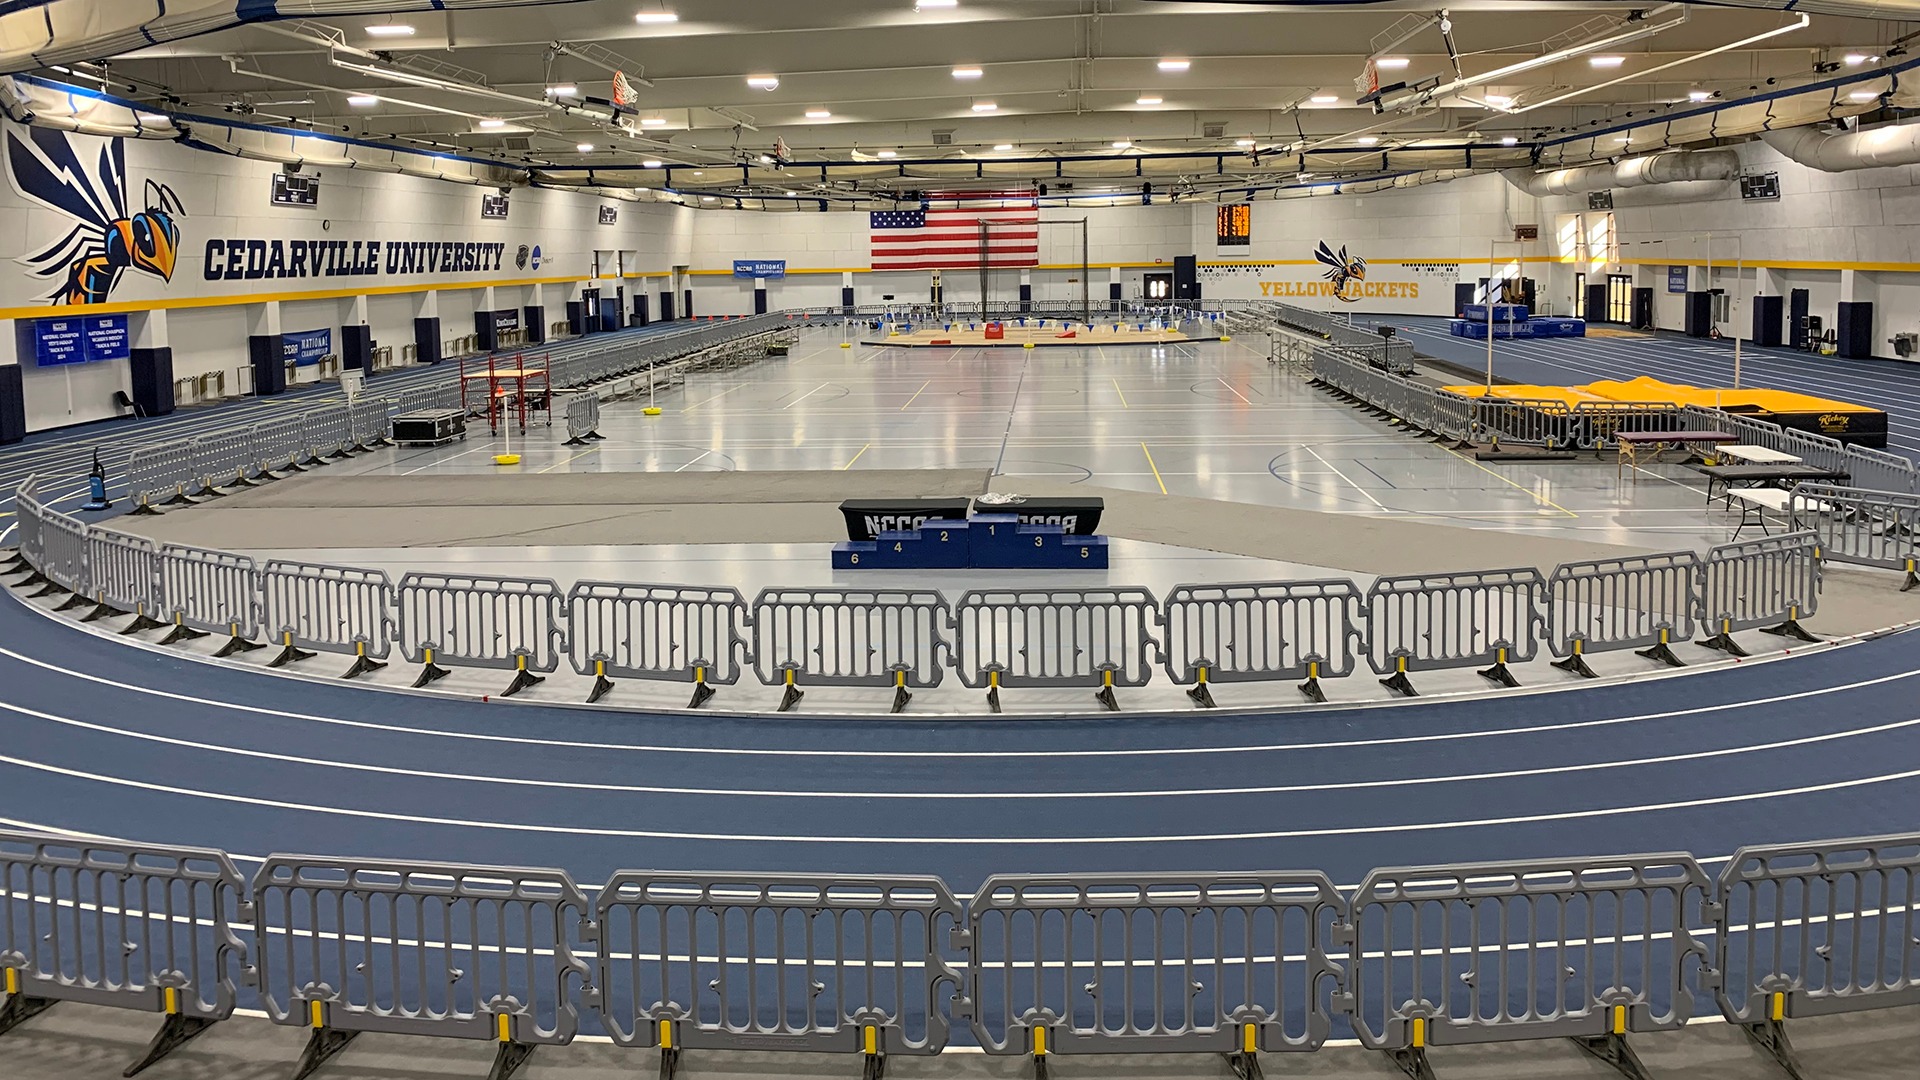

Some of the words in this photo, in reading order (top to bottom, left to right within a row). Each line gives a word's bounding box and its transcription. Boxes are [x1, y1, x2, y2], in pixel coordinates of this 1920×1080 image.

[204, 239, 380, 281] CEDARVILLE
[386, 241, 505, 274] UNIVERSITY
[1259, 281, 1337, 297] YELLOW
[1341, 282, 1419, 298] JACKETS
[301, 336, 328, 349] NATIONAL
[864, 515, 943, 535] NCCA
[988, 525, 995, 536] 1
[940, 530, 949, 542] 2
[1034, 536, 1043, 547] 3
[894, 541, 903, 553] 4
[1080, 547, 1089, 558] 5
[850, 553, 859, 564] 6
